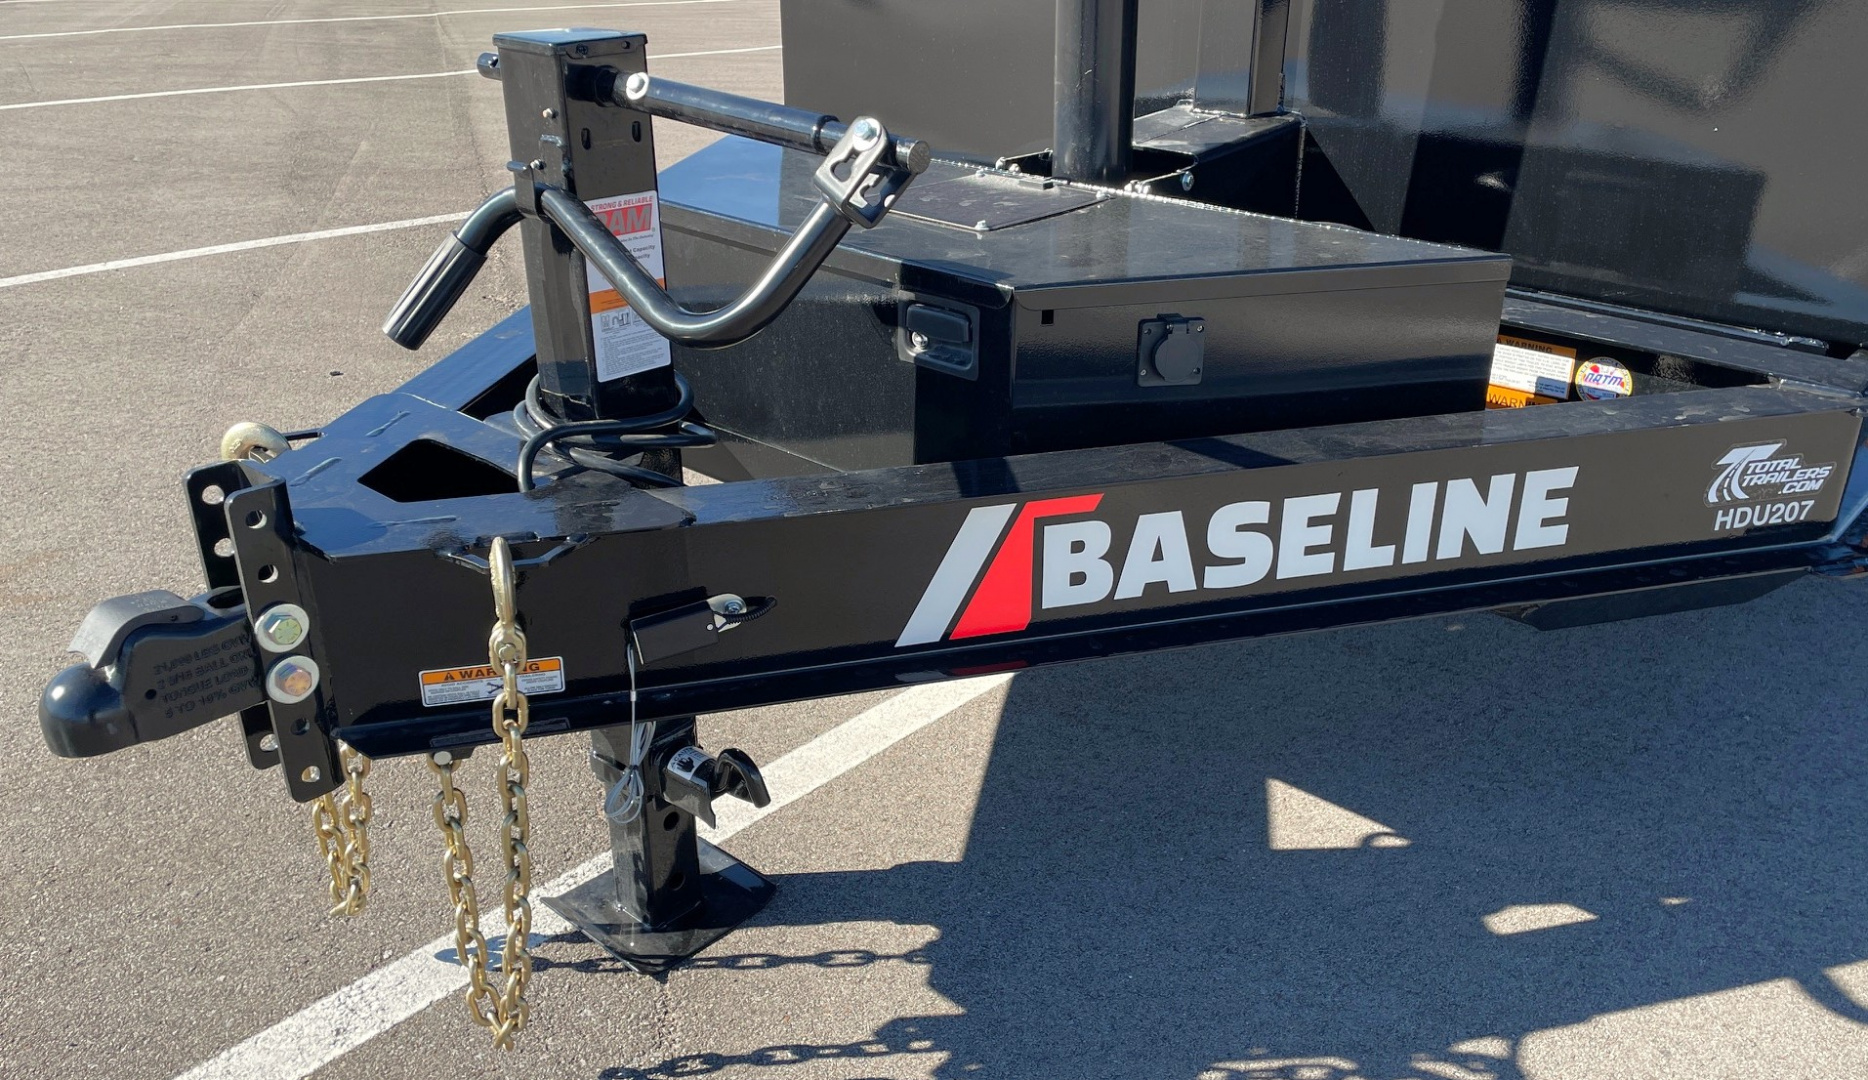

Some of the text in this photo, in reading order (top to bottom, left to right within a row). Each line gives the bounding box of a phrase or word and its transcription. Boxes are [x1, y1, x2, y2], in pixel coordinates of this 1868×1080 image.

[591, 202, 617, 211] STRONG
[623, 196, 654, 207] RELIABLE
[1506, 338, 1553, 353] WARNING
[1746, 457, 1802, 474] TOTAL
[1742, 466, 1833, 487] TRAILERS
[1778, 478, 1825, 495] .COM
[1714, 499, 1815, 531] HDU207
[1041, 465, 1580, 609] BASELINE
